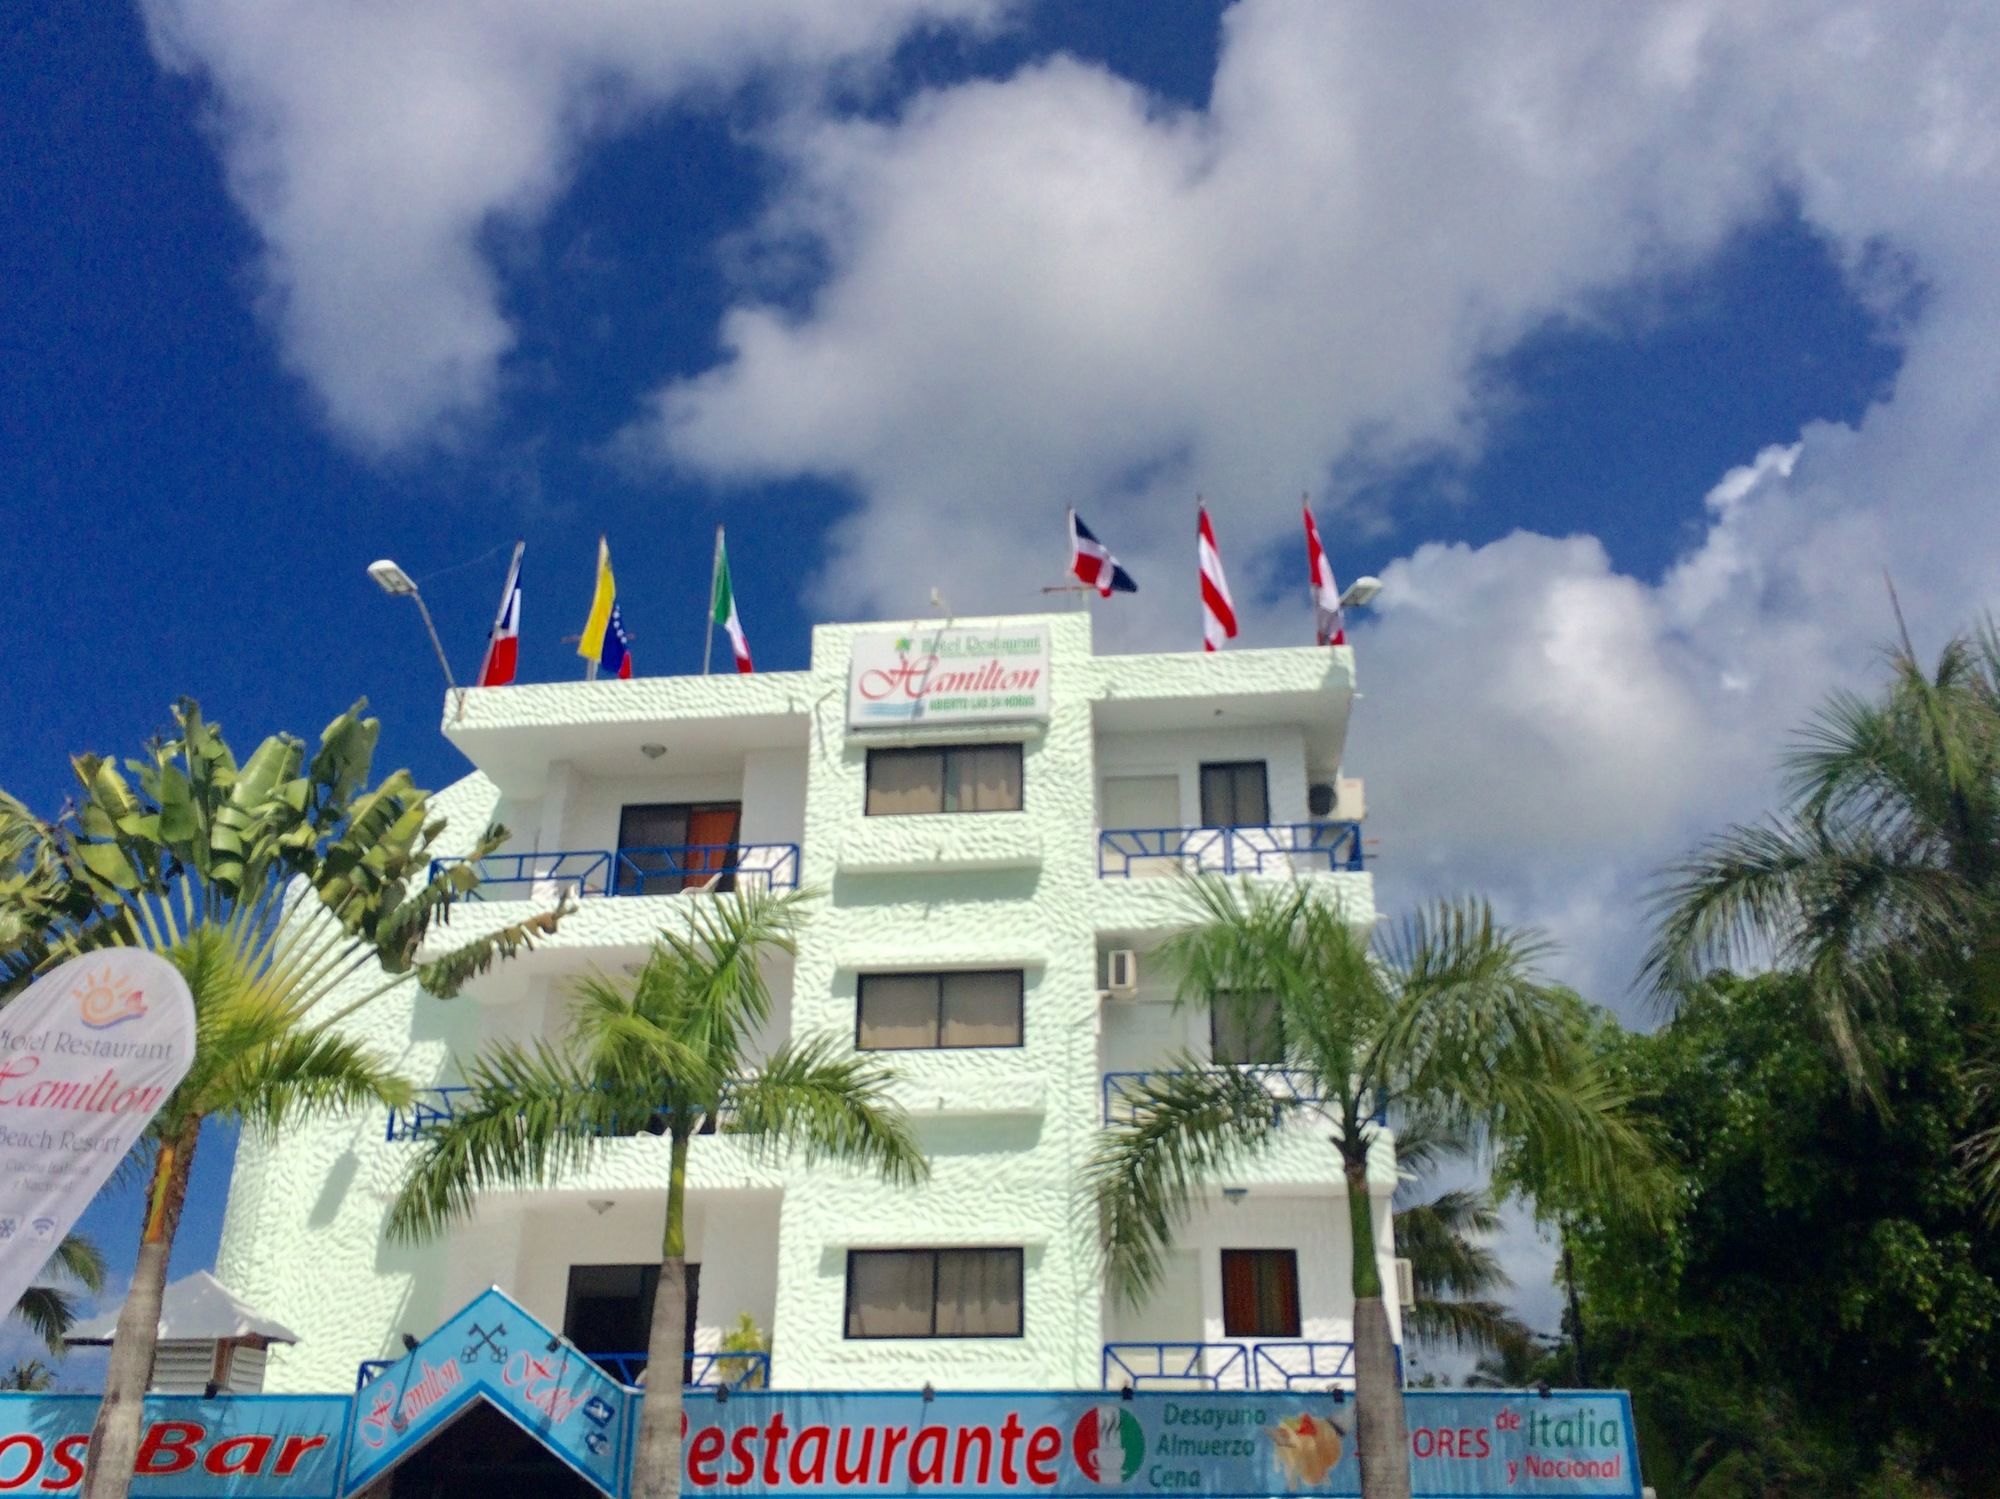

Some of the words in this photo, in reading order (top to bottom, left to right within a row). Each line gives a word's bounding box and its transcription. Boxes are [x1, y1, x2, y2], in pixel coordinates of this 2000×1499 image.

[859, 654, 1040, 700] Hamilton
[55, 1031, 173, 1059] Restaurant
[1164, 1402, 1266, 1431] Desayuno
[1495, 1407, 1521, 1431] de
[1528, 1407, 1620, 1449] Italia
[134, 1420, 328, 1477] Bar
[681, 1410, 1063, 1487] estaurante
[1156, 1433, 1256, 1457] Almuerzo
[1148, 1464, 1201, 1489] Cena
[1507, 1460, 1519, 1484] y
[1525, 1453, 1621, 1479] Nacional
